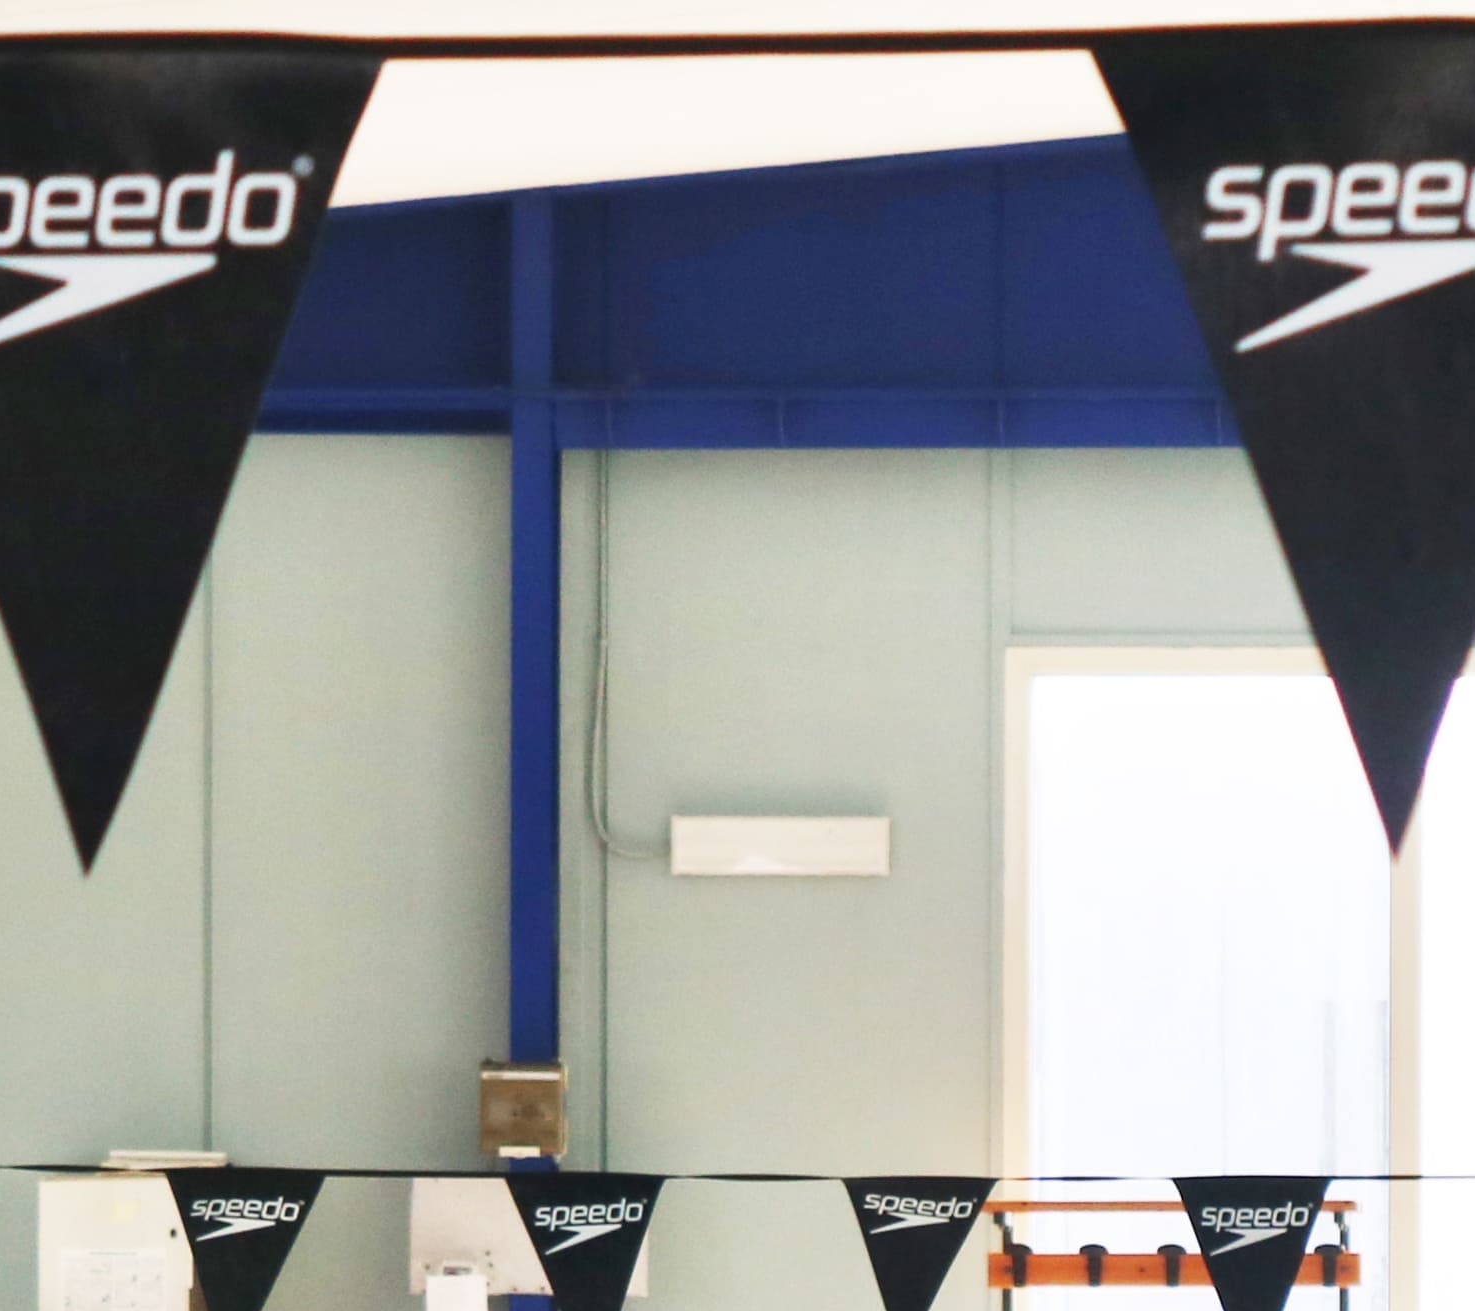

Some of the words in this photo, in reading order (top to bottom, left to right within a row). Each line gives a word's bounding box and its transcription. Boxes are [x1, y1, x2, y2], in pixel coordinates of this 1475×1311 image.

[190, 1197, 299, 1222] speedo
[535, 1199, 643, 1230] speedo
[864, 1192, 972, 1218] speedo
[1201, 1202, 1308, 1230] speedo
